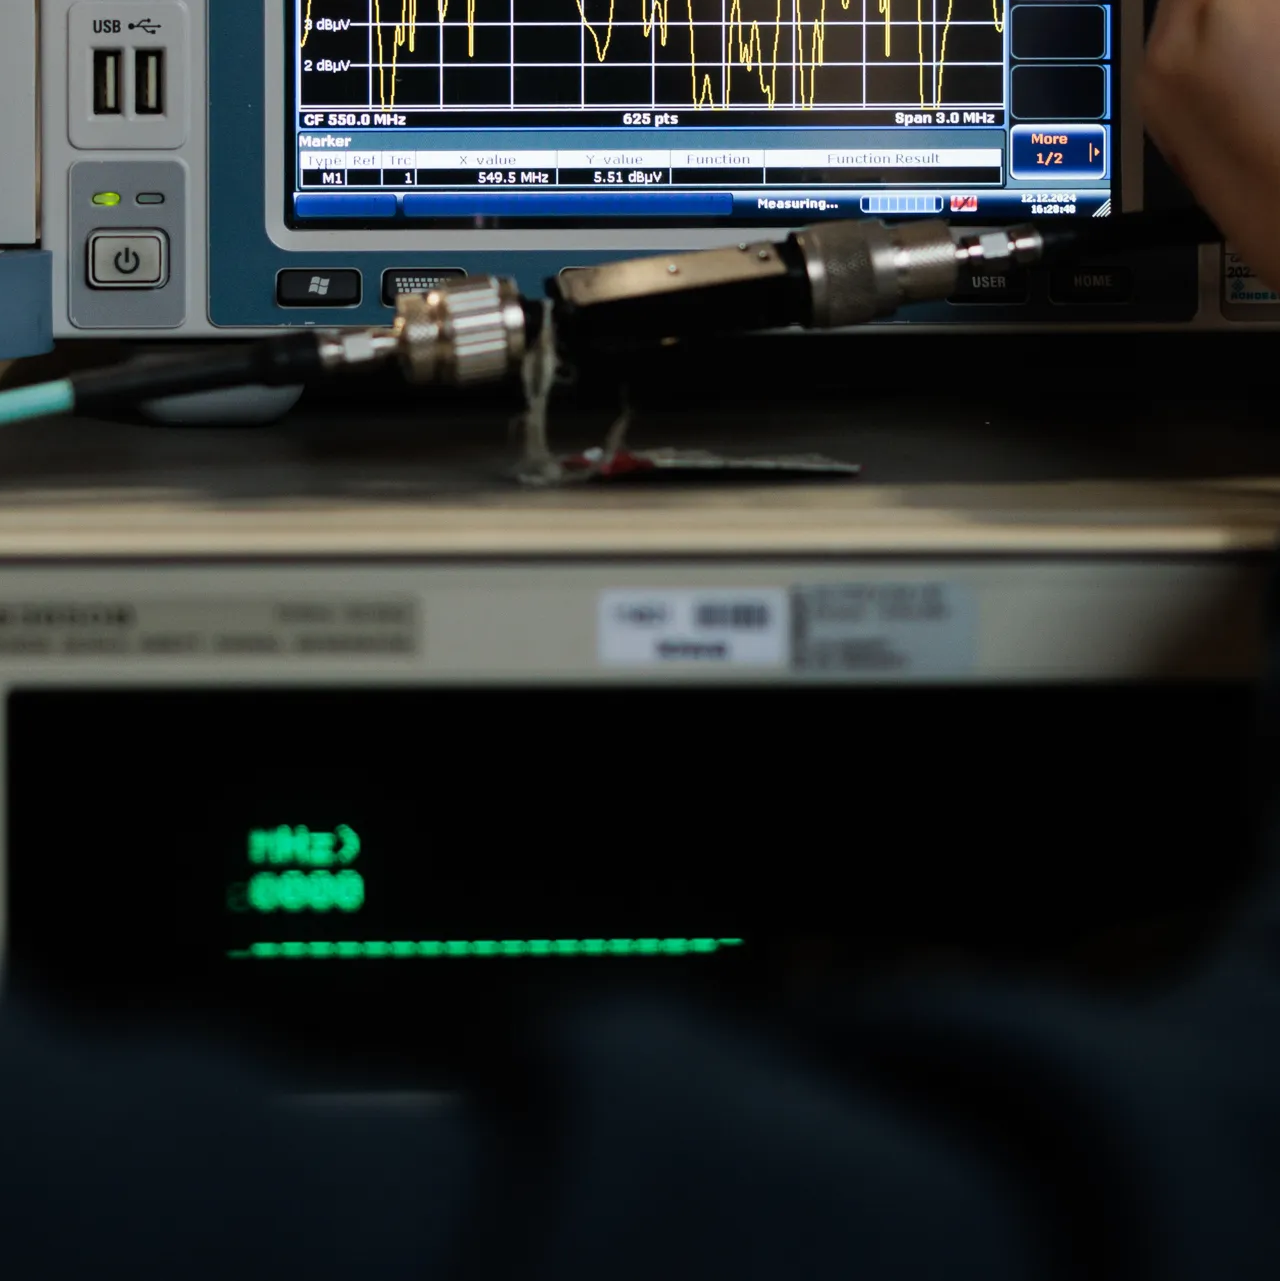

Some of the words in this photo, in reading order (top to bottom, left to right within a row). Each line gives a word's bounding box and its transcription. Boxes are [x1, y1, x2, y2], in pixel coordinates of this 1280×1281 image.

[93, 20, 120, 33] USB
[316, 18, 350, 32] dBµV
[304, 60, 312, 70] 2
[316, 59, 350, 72] dBµV
[304, 114, 324, 126] CF
[328, 114, 370, 126] 550.0
[374, 113, 406, 126] MHz
[623, 113, 651, 125] 625
[655, 113, 678, 127] pts
[895, 112, 932, 126] Span
[936, 112, 960, 124] 3.0
[963, 112, 995, 124] MHz
[299, 135, 352, 148] Marker
[1032, 133, 1068, 145] More
[307, 154, 342, 170] Type
[353, 154, 376, 166] Ref
[389, 154, 412, 166] Trc
[686, 153, 750, 166] Function
[827, 152, 891, 165] Function
[896, 152, 940, 165] Result
[1036, 152, 1063, 164] 1/2
[322, 172, 342, 184] M1
[404, 172, 412, 184] 1
[478, 172, 516, 184] 549.5
[520, 172, 550, 184] MHz
[594, 172, 624, 183] 5.51
[628, 170, 662, 185] dBµV
[758, 198, 838, 211] Measuring...
[972, 276, 1006, 288] USER
[1074, 274, 1113, 288] HOME
